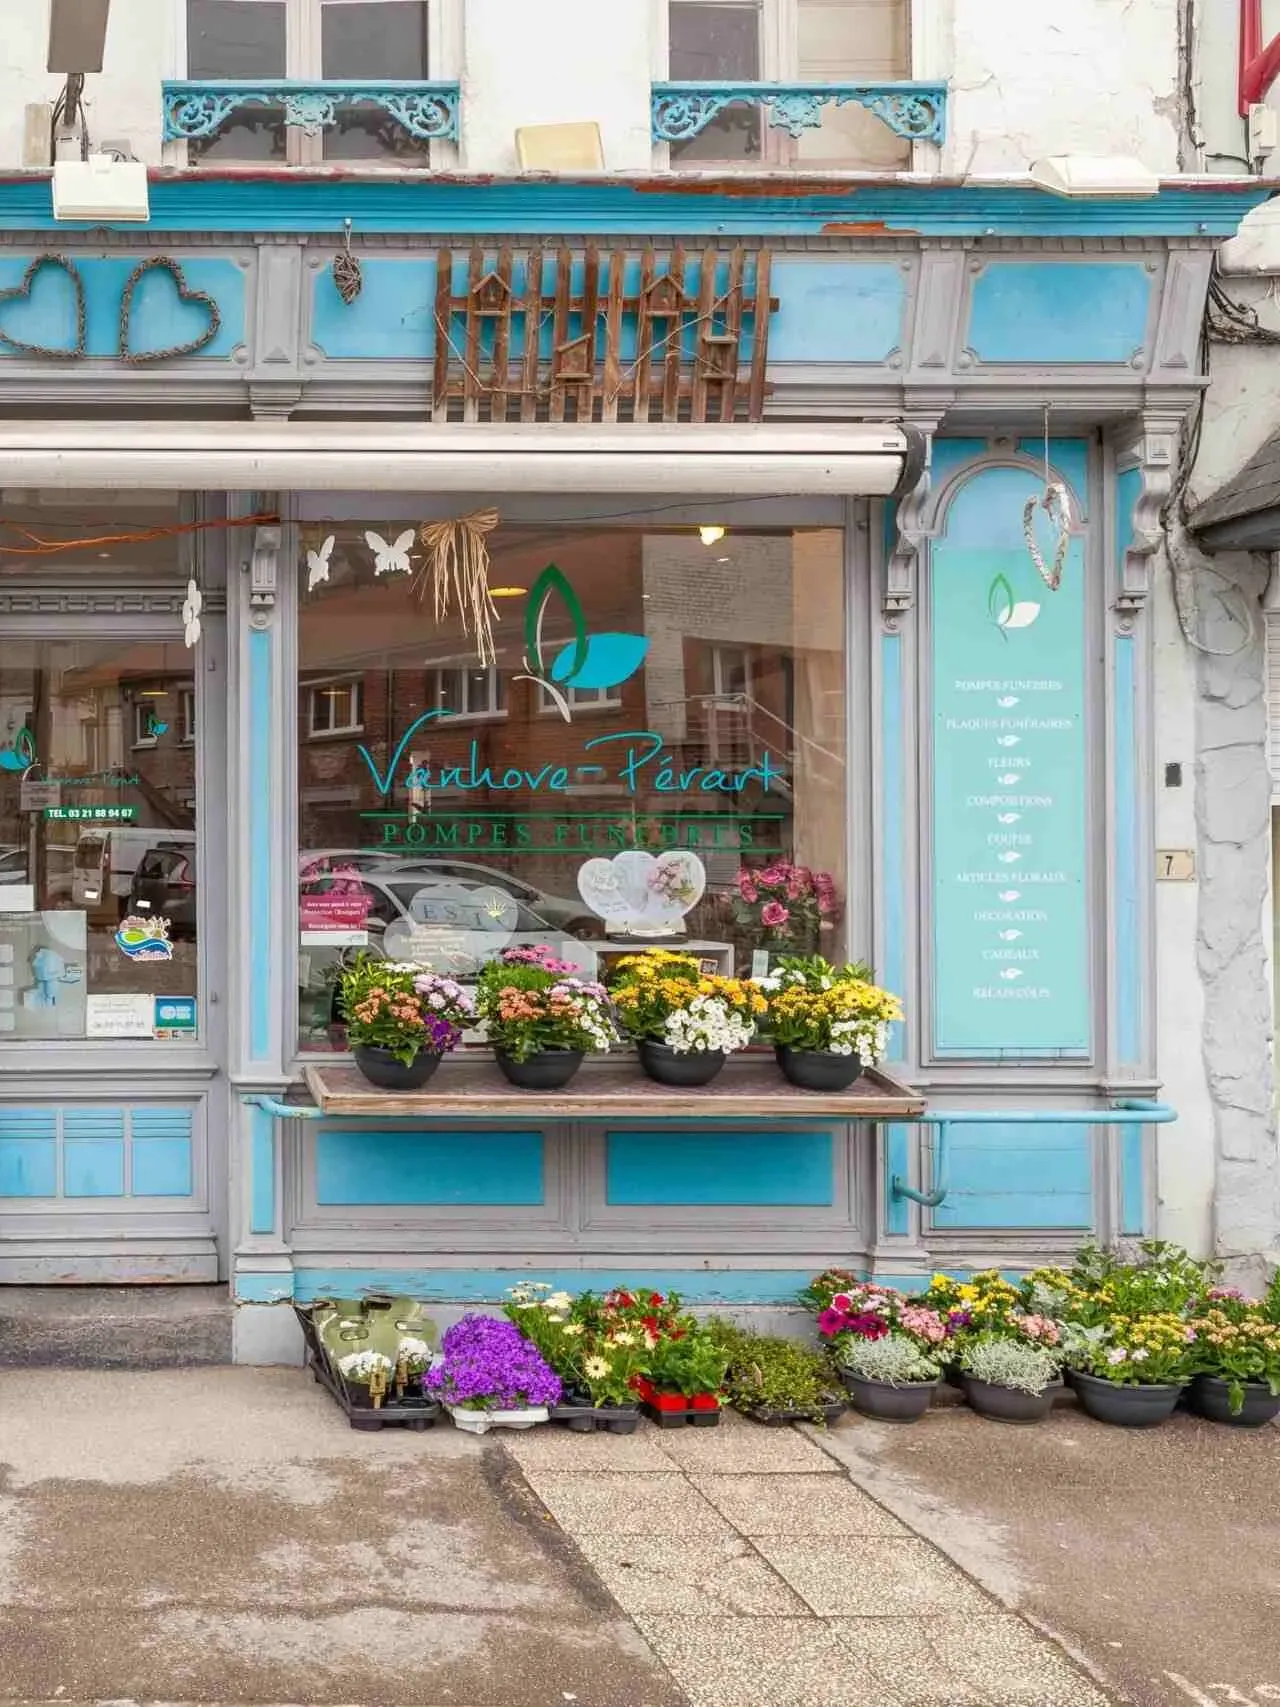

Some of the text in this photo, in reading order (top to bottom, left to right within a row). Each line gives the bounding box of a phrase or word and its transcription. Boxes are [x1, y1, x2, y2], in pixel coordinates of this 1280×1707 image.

[988, 757, 1031, 769] FLEURS
[967, 795, 1052, 807] COMPOSITIONS
[383, 823, 533, 844] POMPES
[1165, 855, 1173, 876] 7
[981, 948, 1040, 960] CADEAUX
